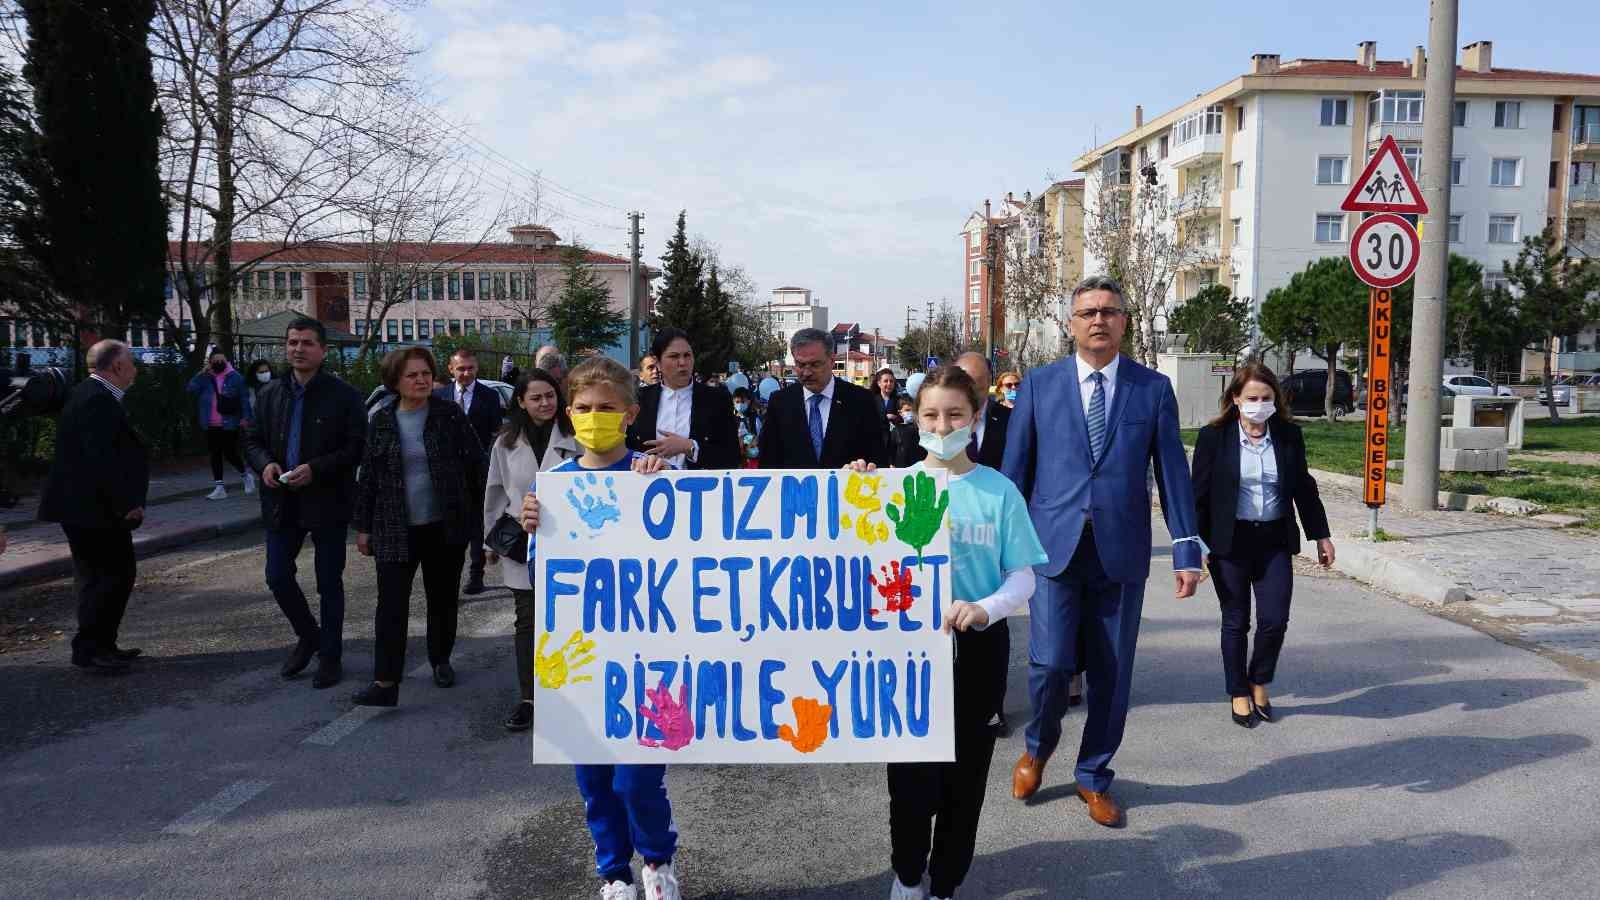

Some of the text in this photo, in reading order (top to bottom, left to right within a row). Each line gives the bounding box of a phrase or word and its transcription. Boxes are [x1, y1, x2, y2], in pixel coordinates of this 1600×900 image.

[1366, 232, 1405, 270] 30
[1371, 290, 1390, 500] OKUL BÖLGESİ
[545, 557, 679, 634] FARK
[899, 555, 950, 632] ET
[604, 650, 932, 742] BİZİMLE YÜRÜ
